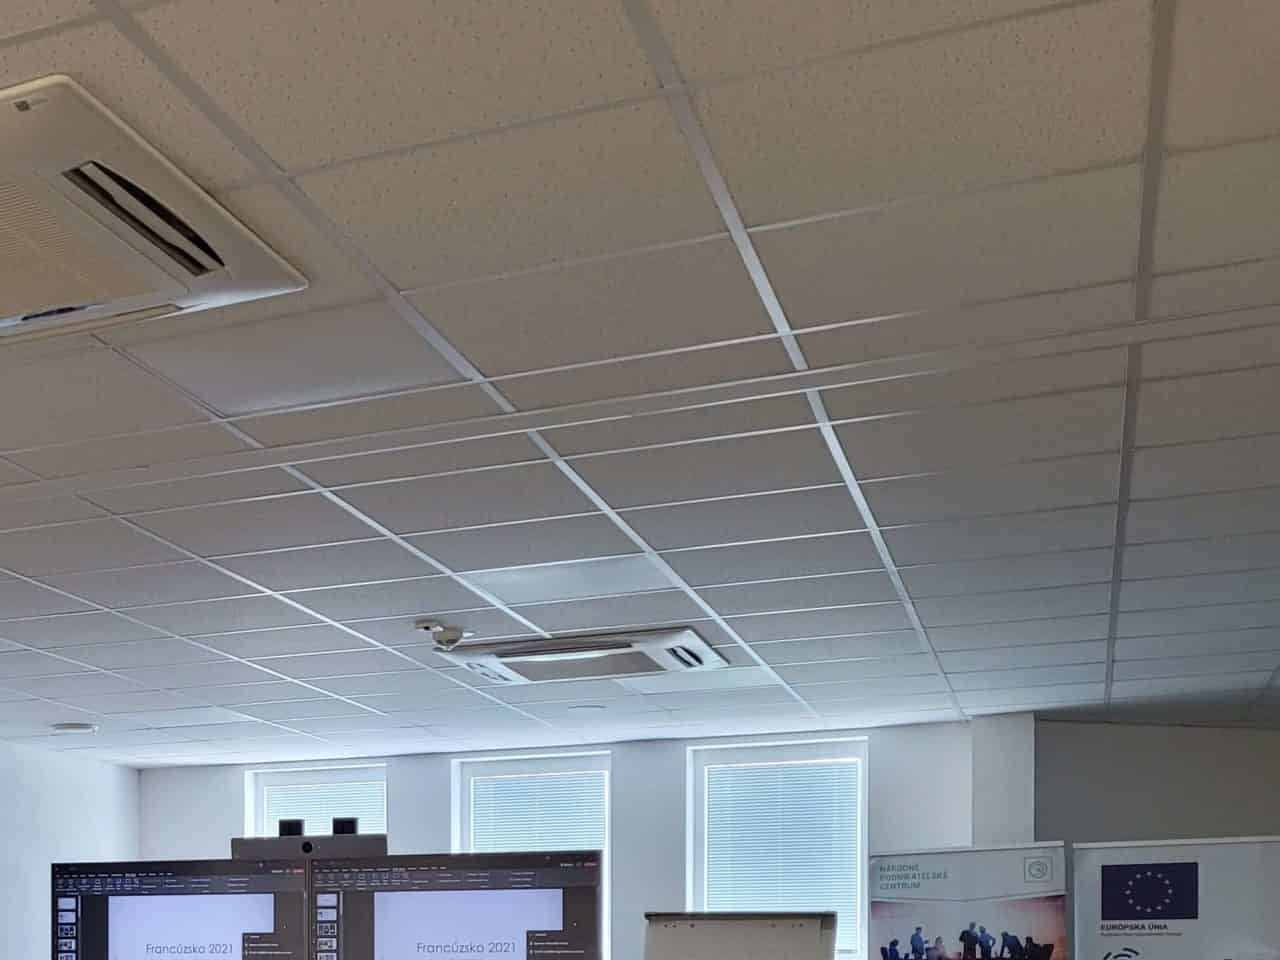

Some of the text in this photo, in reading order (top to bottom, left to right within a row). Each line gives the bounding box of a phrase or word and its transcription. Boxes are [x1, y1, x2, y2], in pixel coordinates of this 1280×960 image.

[145, 943, 206, 954] Francúzsko
[208, 943, 233, 954] 2021
[416, 941, 485, 953] Francúzsko
[488, 941, 516, 953] 2021
